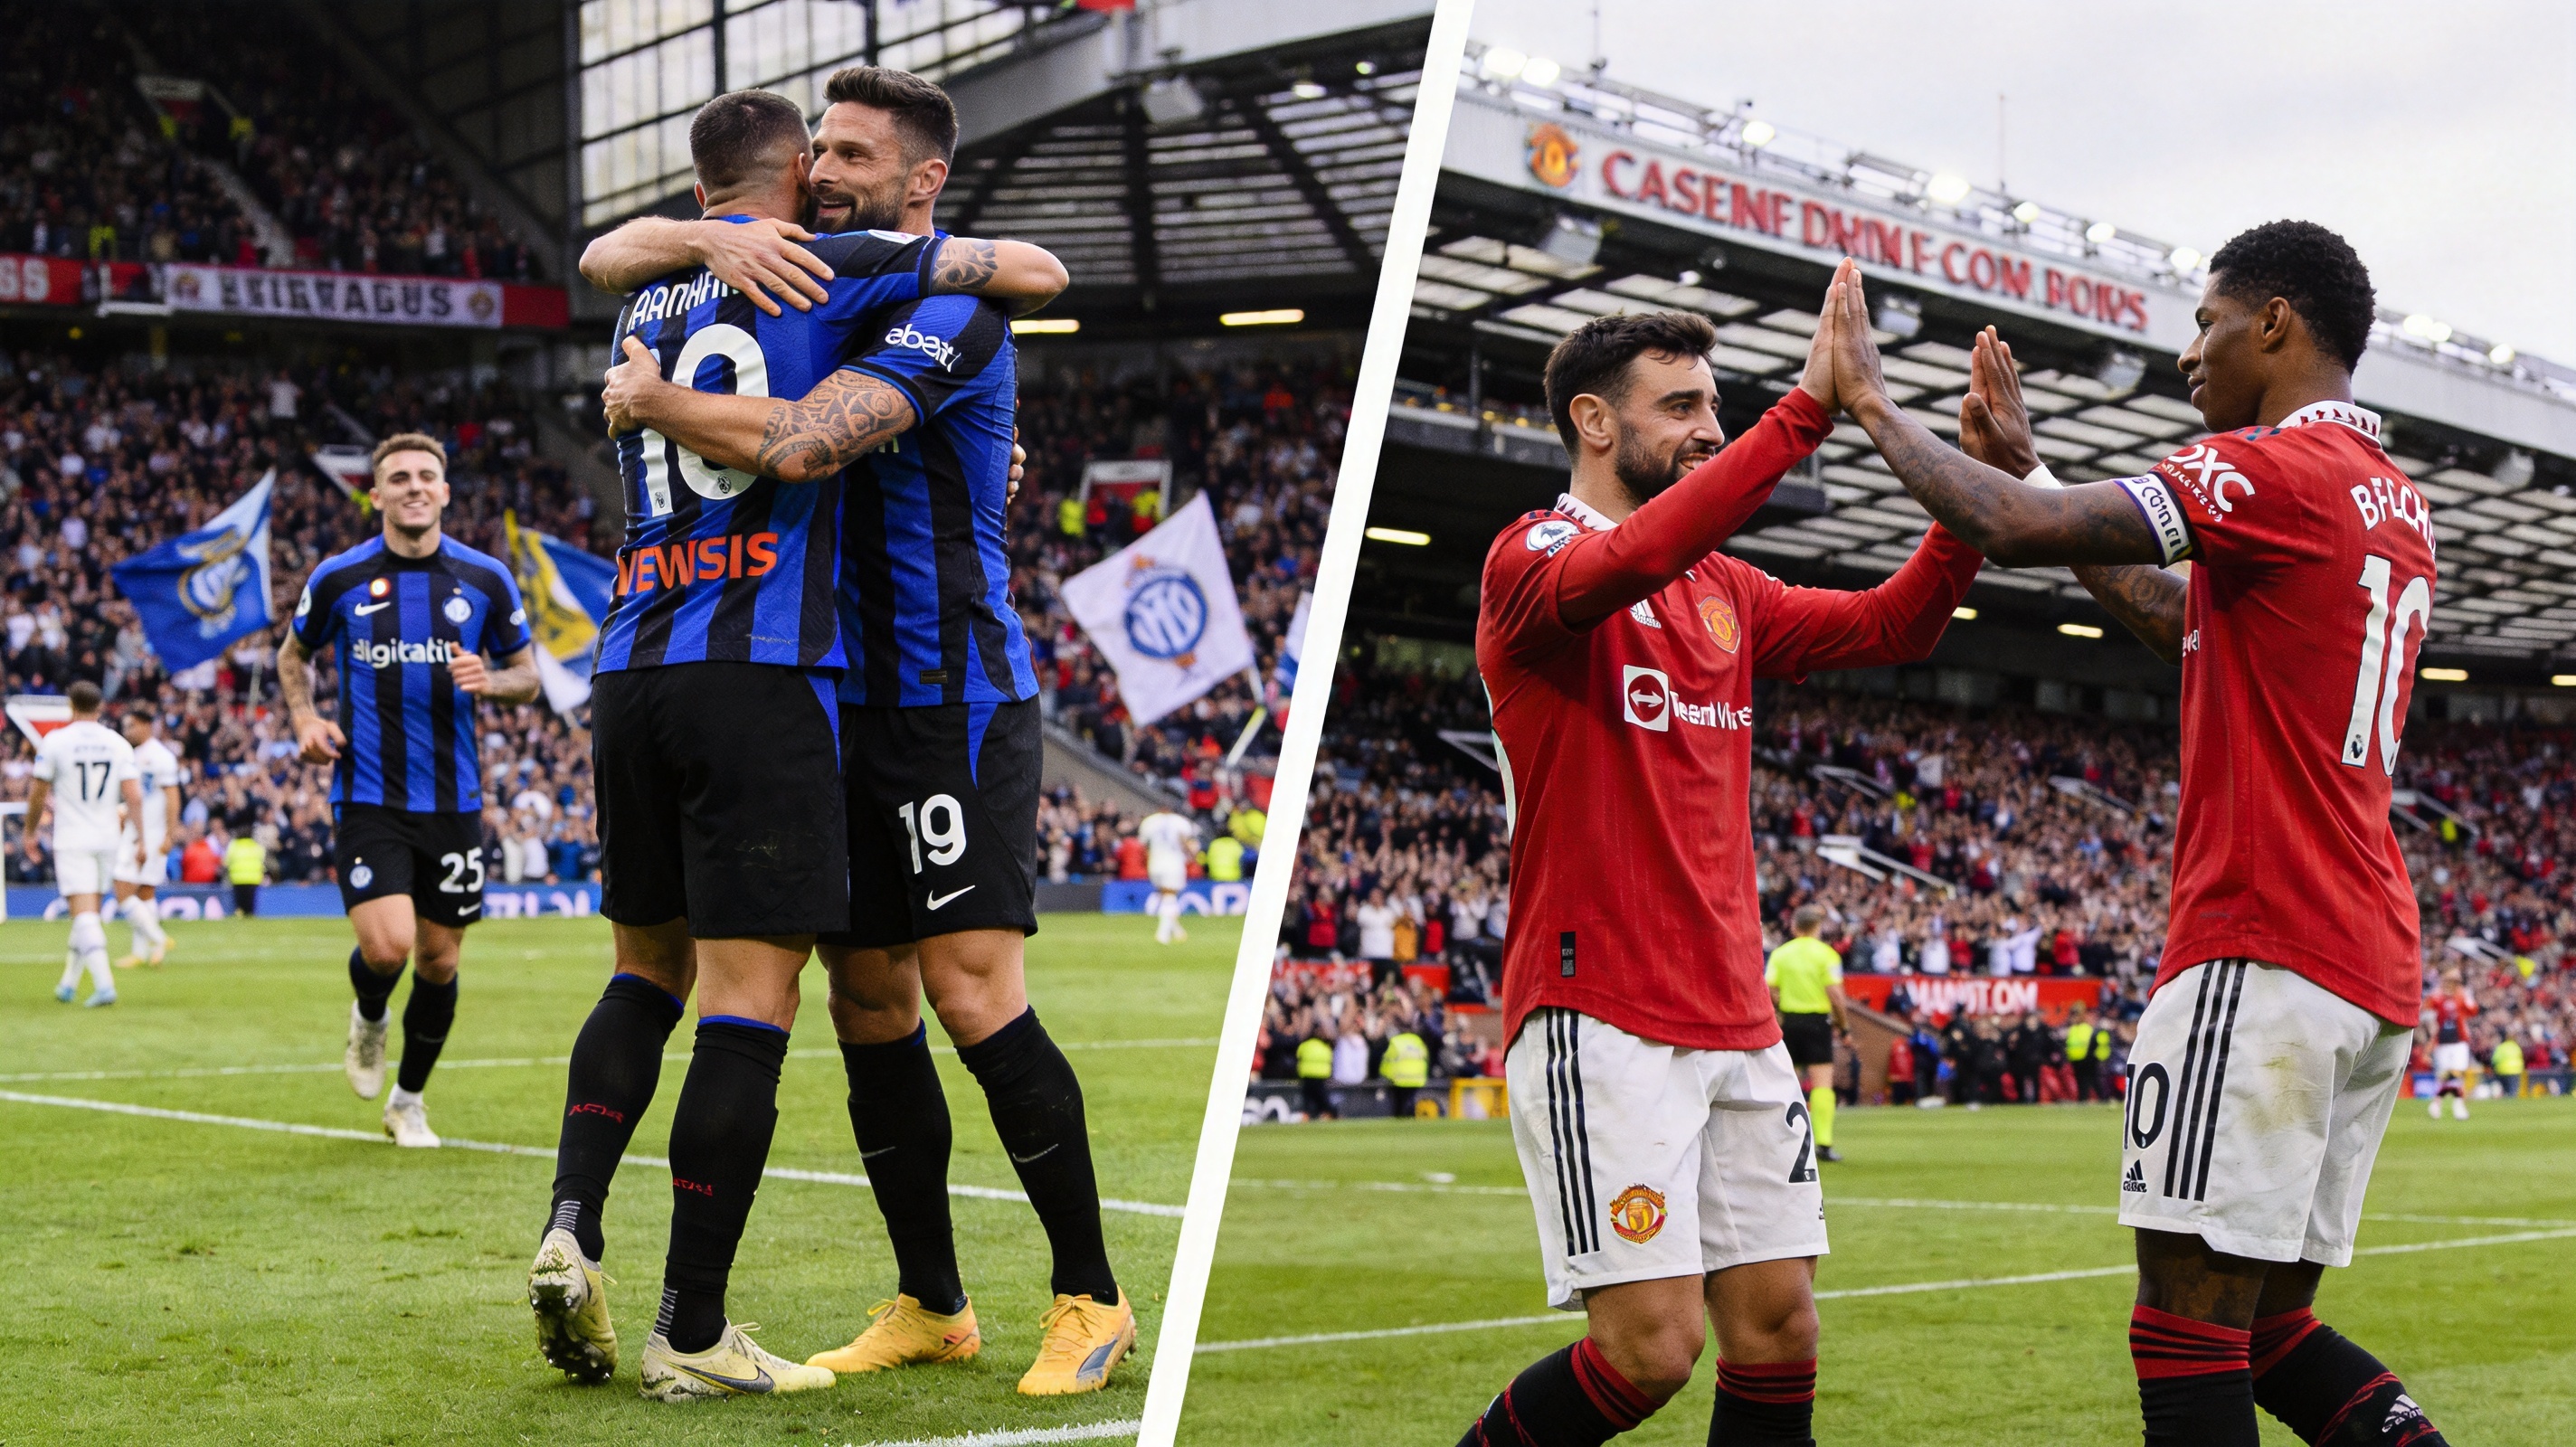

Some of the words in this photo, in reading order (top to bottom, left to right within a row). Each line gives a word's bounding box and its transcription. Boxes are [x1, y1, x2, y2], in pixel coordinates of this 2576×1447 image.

[74, 761, 110, 801] 17
[898, 794, 966, 875] 19
[439, 846, 485, 893] 25
